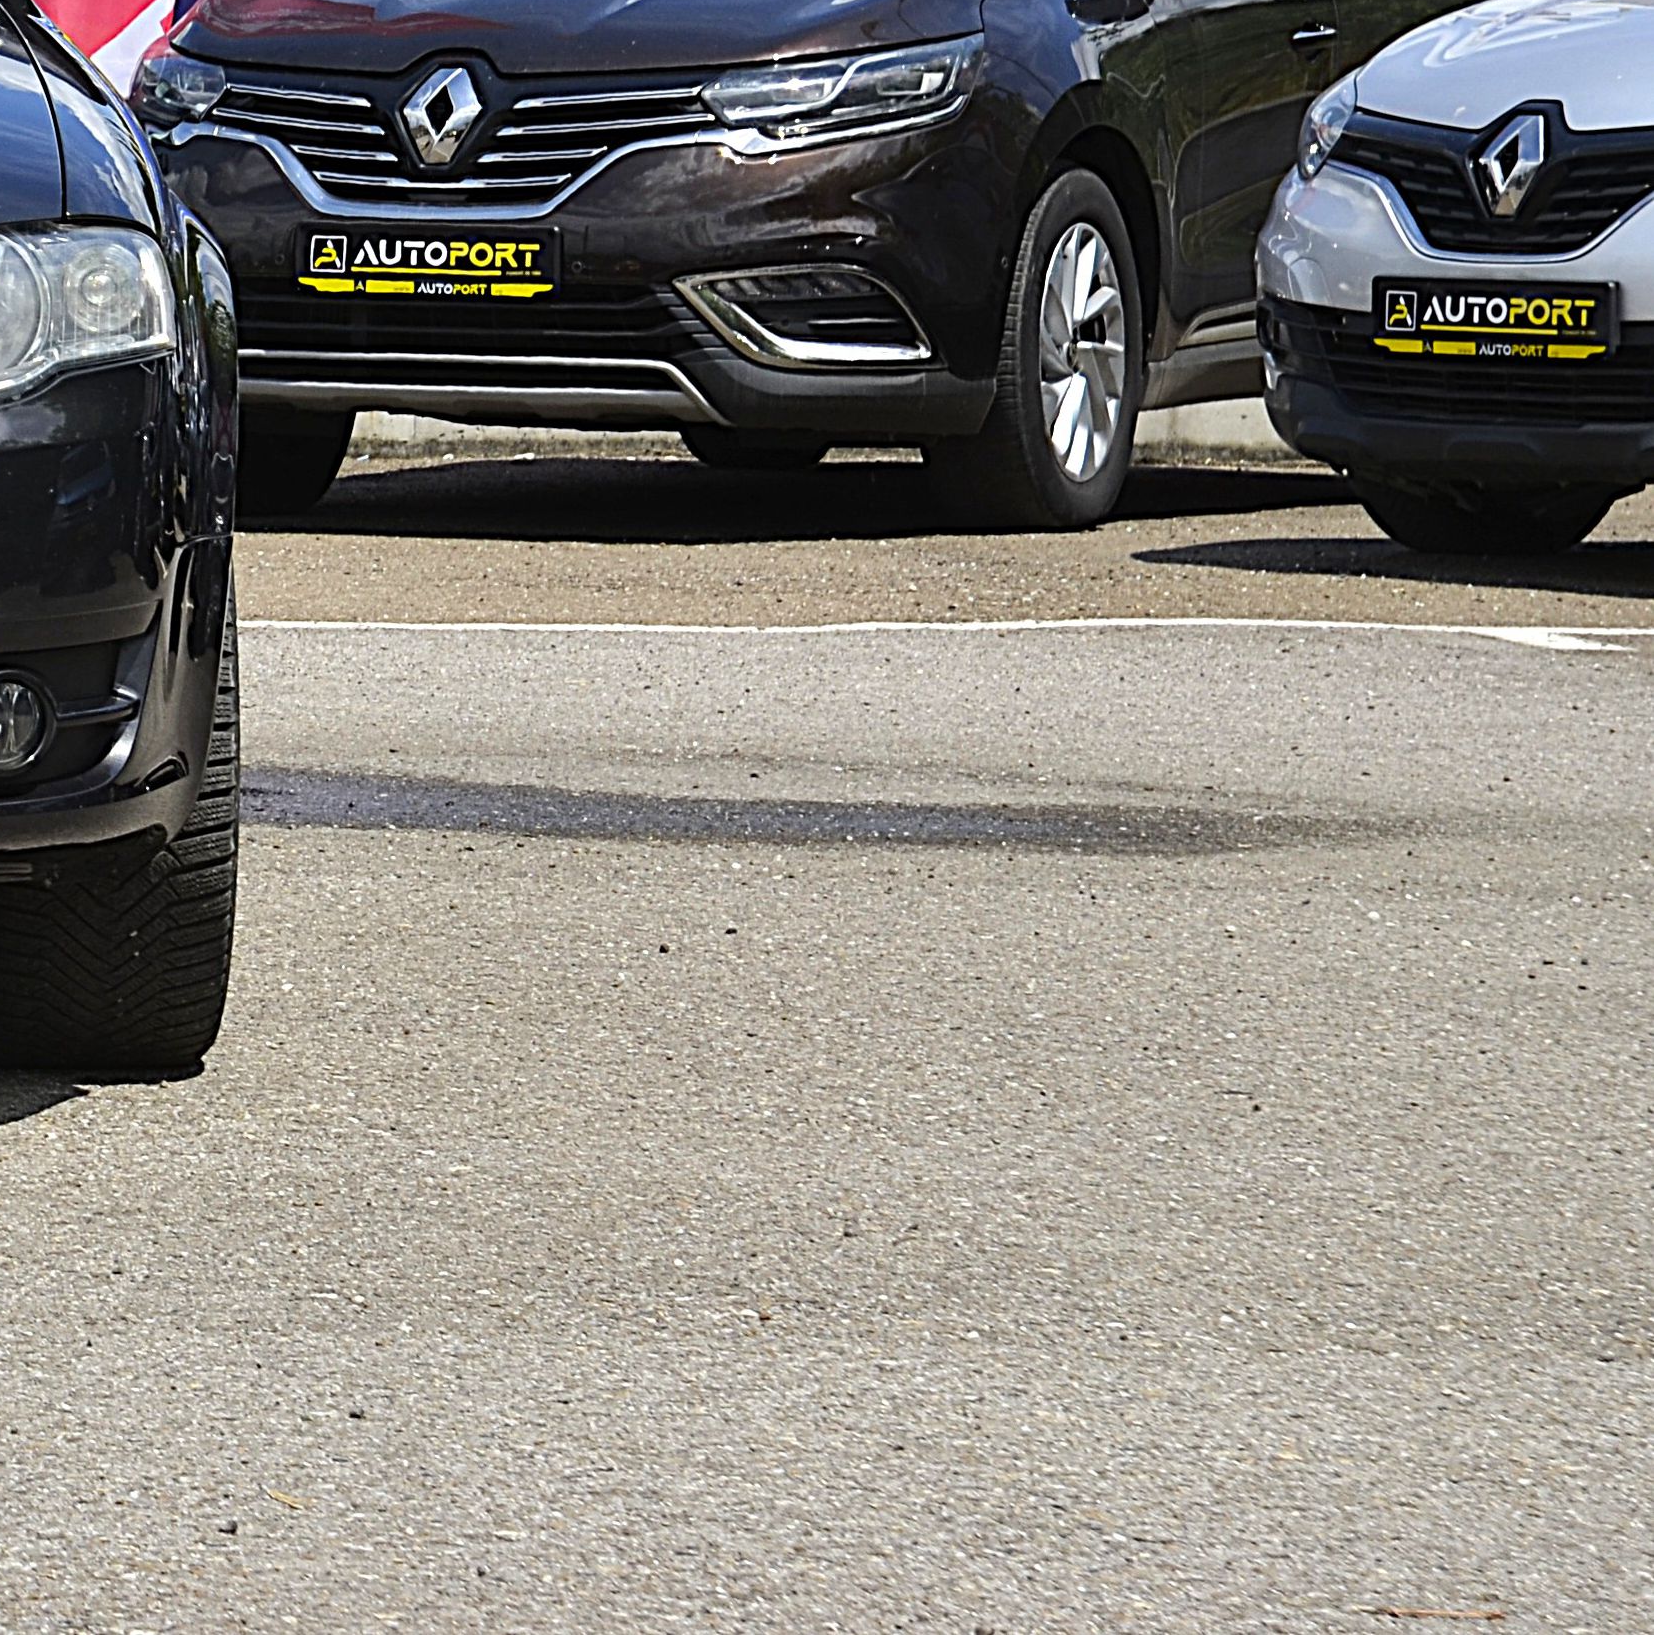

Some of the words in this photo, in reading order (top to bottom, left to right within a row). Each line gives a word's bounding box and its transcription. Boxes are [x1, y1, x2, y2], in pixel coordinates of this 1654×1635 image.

[353, 238, 541, 268] AUTOPORT
[417, 282, 488, 296] AUTOPORT
[1422, 295, 1595, 327] AUTOPORT
[1479, 343, 1544, 357] AUTOPORT
